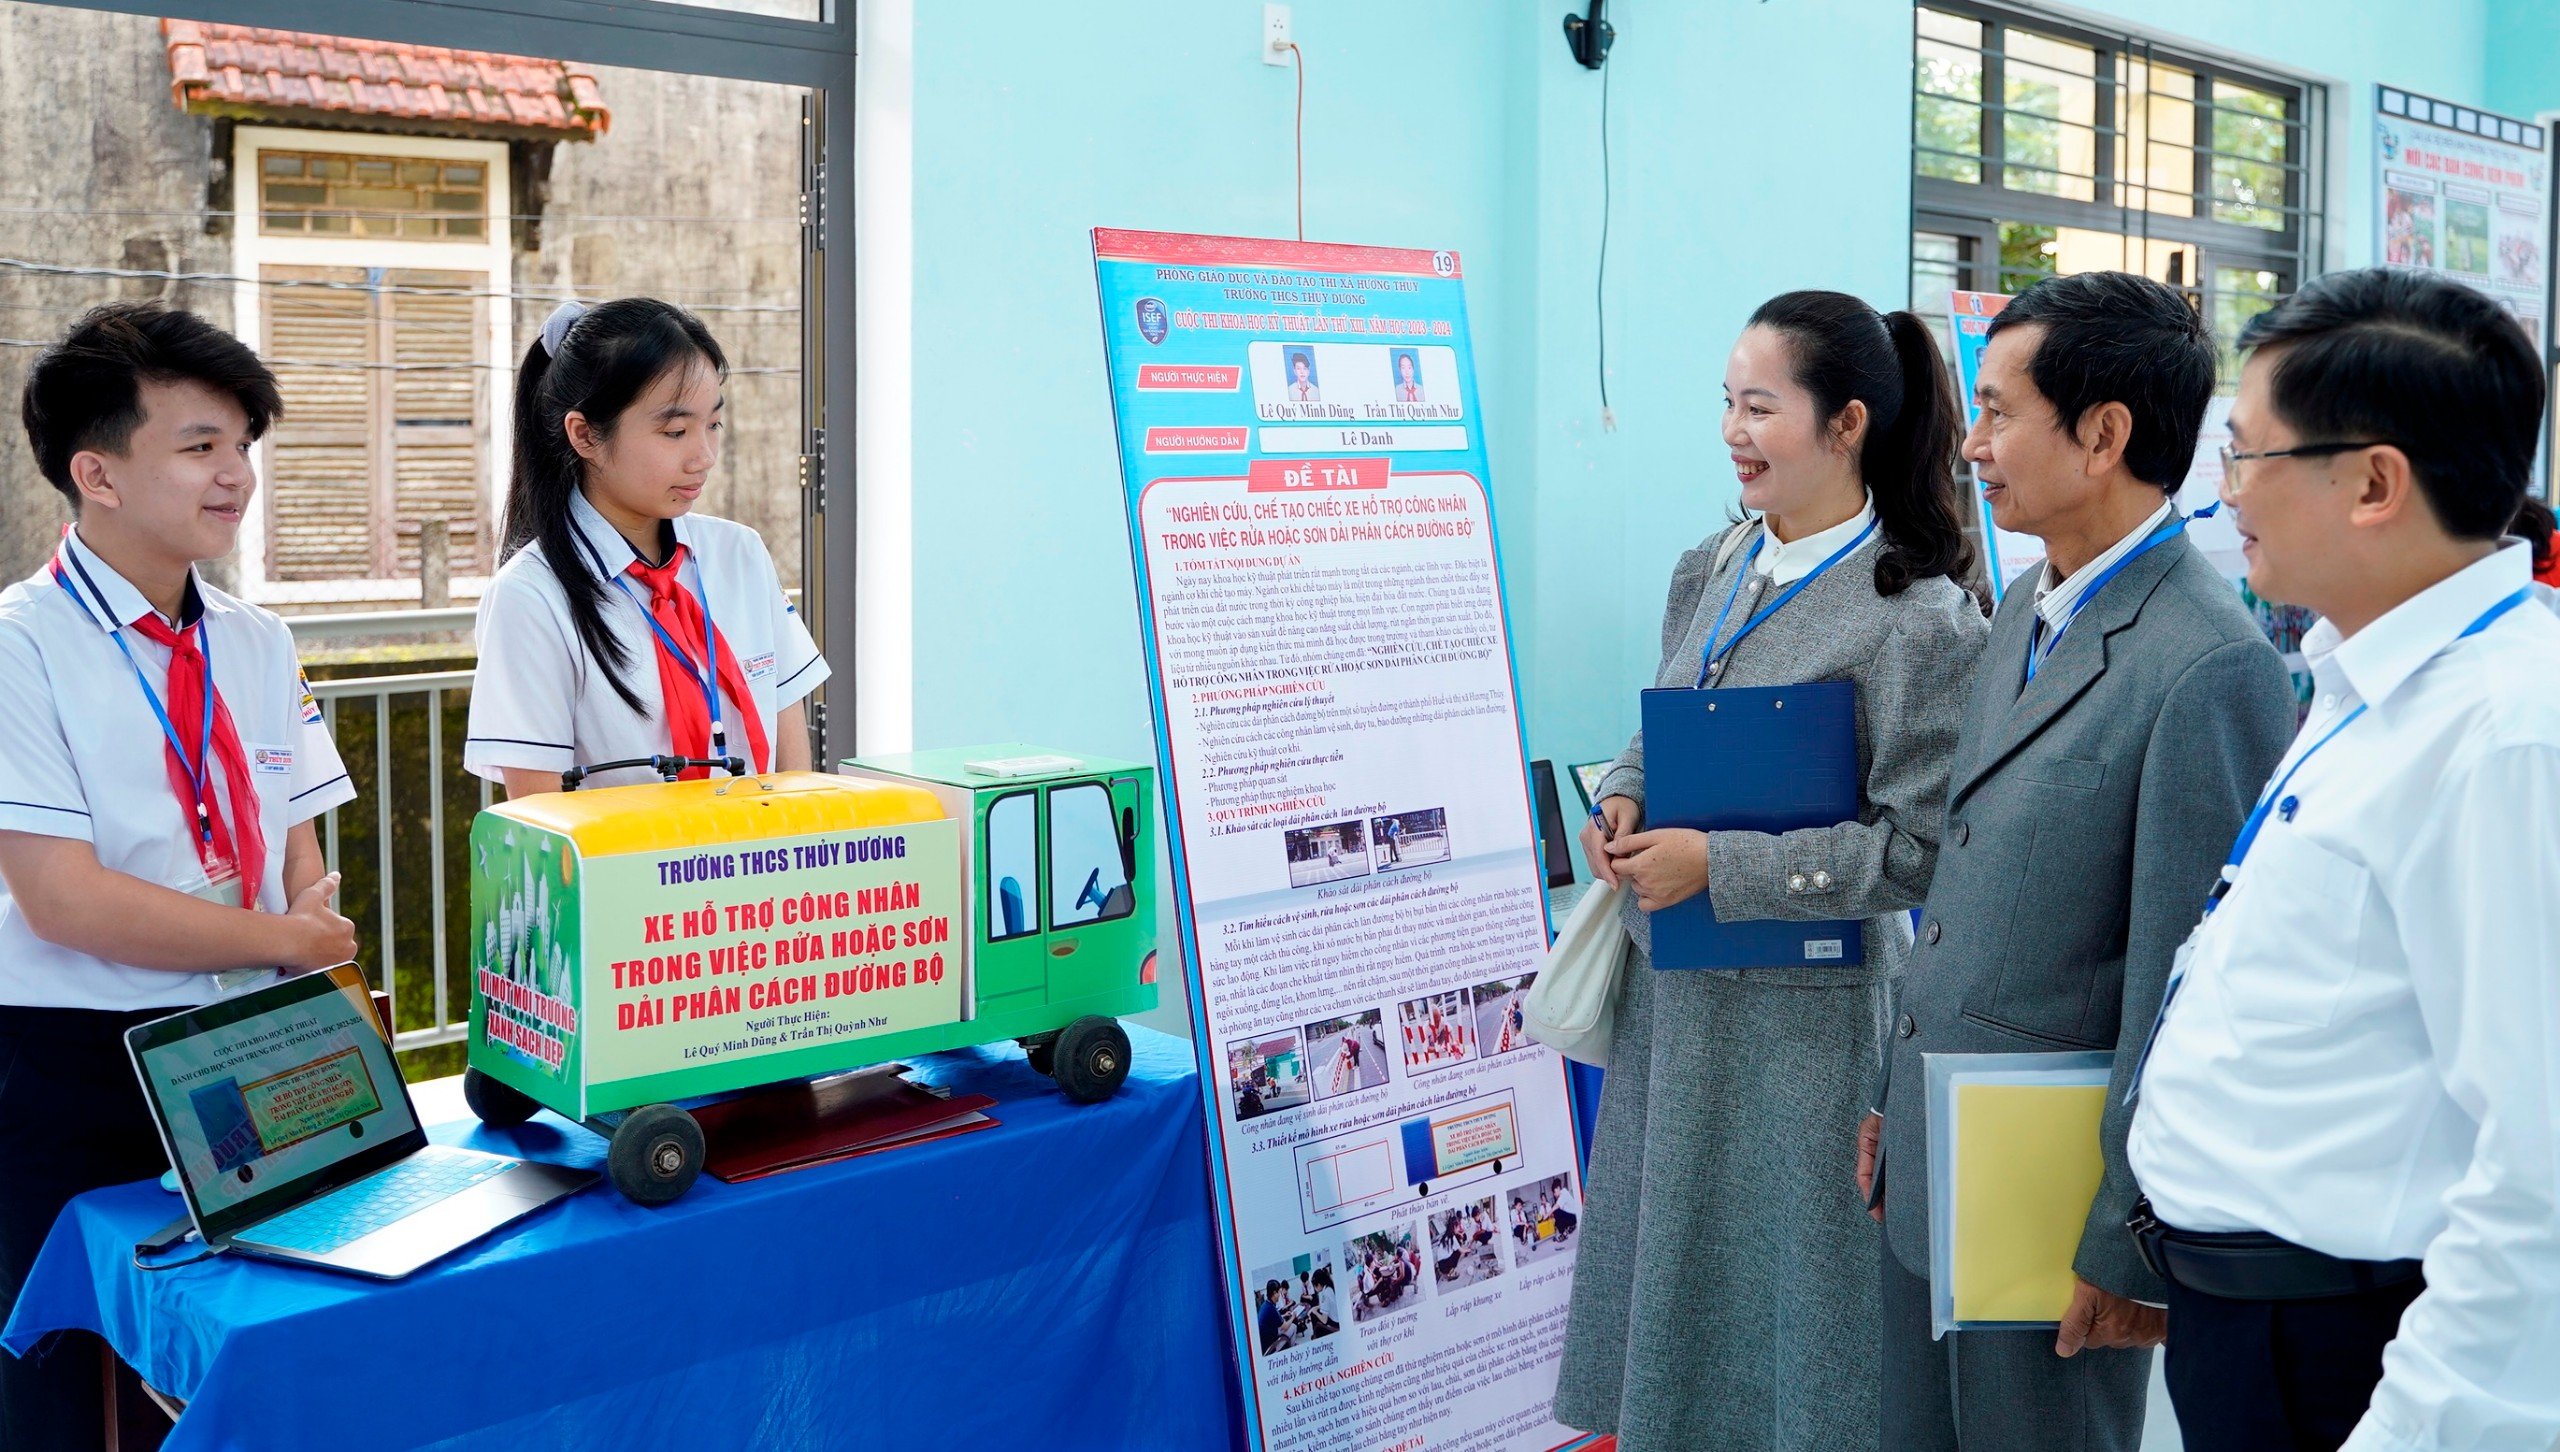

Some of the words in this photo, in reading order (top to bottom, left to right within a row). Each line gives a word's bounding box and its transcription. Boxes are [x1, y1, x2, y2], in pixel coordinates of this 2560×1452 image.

[1436, 256, 1451, 271] 19
[1223, 287, 1267, 301] TRƯỜNG
[1270, 291, 1298, 302] THCS
[1332, 293, 1365, 305] DƯƠNG
[1142, 312, 1161, 323] ISEF
[1151, 369, 1180, 382] NGƯỜI
[1181, 372, 1205, 383] THỰC
[1207, 371, 1228, 383] HIỆN
[1260, 403, 1274, 421] Lê
[1276, 404, 1296, 421] Quý
[1300, 404, 1327, 421] Minh
[1328, 404, 1356, 422] Dũng
[1363, 404, 1388, 421] Trần
[1389, 404, 1406, 421] Thị
[1407, 404, 1438, 421] Quỳnh
[1439, 404, 1460, 421] Như
[1155, 434, 1186, 448] NGƯỜI
[1186, 436, 1218, 447] HƯỚNG
[1220, 432, 1239, 447] DẪN
[1341, 431, 1357, 446] Lê
[1360, 431, 1393, 445] Danh
[1284, 462, 1314, 487] ĐỀ
[1321, 464, 1358, 486] TÀI
[1222, 500, 1251, 523] CỨU,
[1254, 497, 1279, 520] CHẾ
[1280, 502, 1305, 522] TẠO
[1307, 495, 1342, 522] CHIẾC
[1344, 501, 1360, 516] XE
[1361, 494, 1378, 515] HỖ
[1380, 497, 1403, 517] TRỢ
[1405, 495, 1436, 514] CÔNG
[1438, 493, 1467, 512] NHÂN
[1161, 532, 1206, 550] TRONG
[1208, 527, 1237, 551] VIỆC
[1240, 525, 1266, 546] RỬA
[1268, 526, 1301, 548] HOẶC
[1303, 526, 1327, 544] SƠN
[1330, 521, 1349, 542] DẢI
[1351, 521, 1382, 541] PHÂN
[1384, 520, 1414, 540] CÁCH
[1417, 519, 1454, 538] ĐƯỜNG
[1192, 693, 1200, 703] 2.
[1200, 690, 1242, 702] PHƯƠNG
[1243, 684, 1268, 698] PHÁP
[1269, 680, 1305, 694] NGHIÊN
[1305, 679, 1325, 692] CỨU
[658, 854, 735, 886] TRƯỜNG
[740, 848, 788, 876] THCS
[793, 839, 840, 870] THỦY
[845, 835, 905, 864] DƯƠNG
[644, 914, 675, 944] XE
[683, 900, 717, 938] HỖ
[724, 897, 774, 932] TRỢ
[782, 892, 849, 925] CÔNG
[857, 881, 919, 915] NHÂN
[611, 952, 701, 989] TRONG
[709, 940, 767, 976] VIỆC
[775, 931, 825, 966] RỬA
[832, 923, 896, 958] HOẶC
[903, 915, 948, 947] SƠN
[618, 994, 663, 1030] DẢI
[673, 985, 740, 1022] PHÂN
[749, 975, 816, 1010] CÁCH
[824, 956, 906, 998] ĐƯỜNG
[914, 952, 943, 986] BỘ
[535, 994, 575, 1033] TRƯỜNG
[746, 1017, 775, 1032] Người
[777, 1015, 802, 1026] Thực
[804, 1010, 830, 1029] Hiện:
[489, 1012, 514, 1044] XANH
[515, 1023, 542, 1057] SẠCH
[684, 1046, 697, 1059] Lê
[699, 1043, 720, 1058] Quý
[723, 1039, 748, 1052] Minh
[751, 1030, 777, 1047] Dũng
[779, 1032, 787, 1042] &
[790, 1024, 814, 1040] Trần
[816, 1020, 832, 1037] Thị
[834, 1019, 866, 1035] Quỳnh
[868, 1016, 888, 1028] Như
[1283, 1390, 1292, 1400] 4.
[1293, 1381, 1313, 1397] KẾT
[1314, 1371, 1335, 1391] QUẢ
[1337, 1360, 1373, 1382] NGHIÊN
[1374, 1352, 1394, 1367] CỨU
